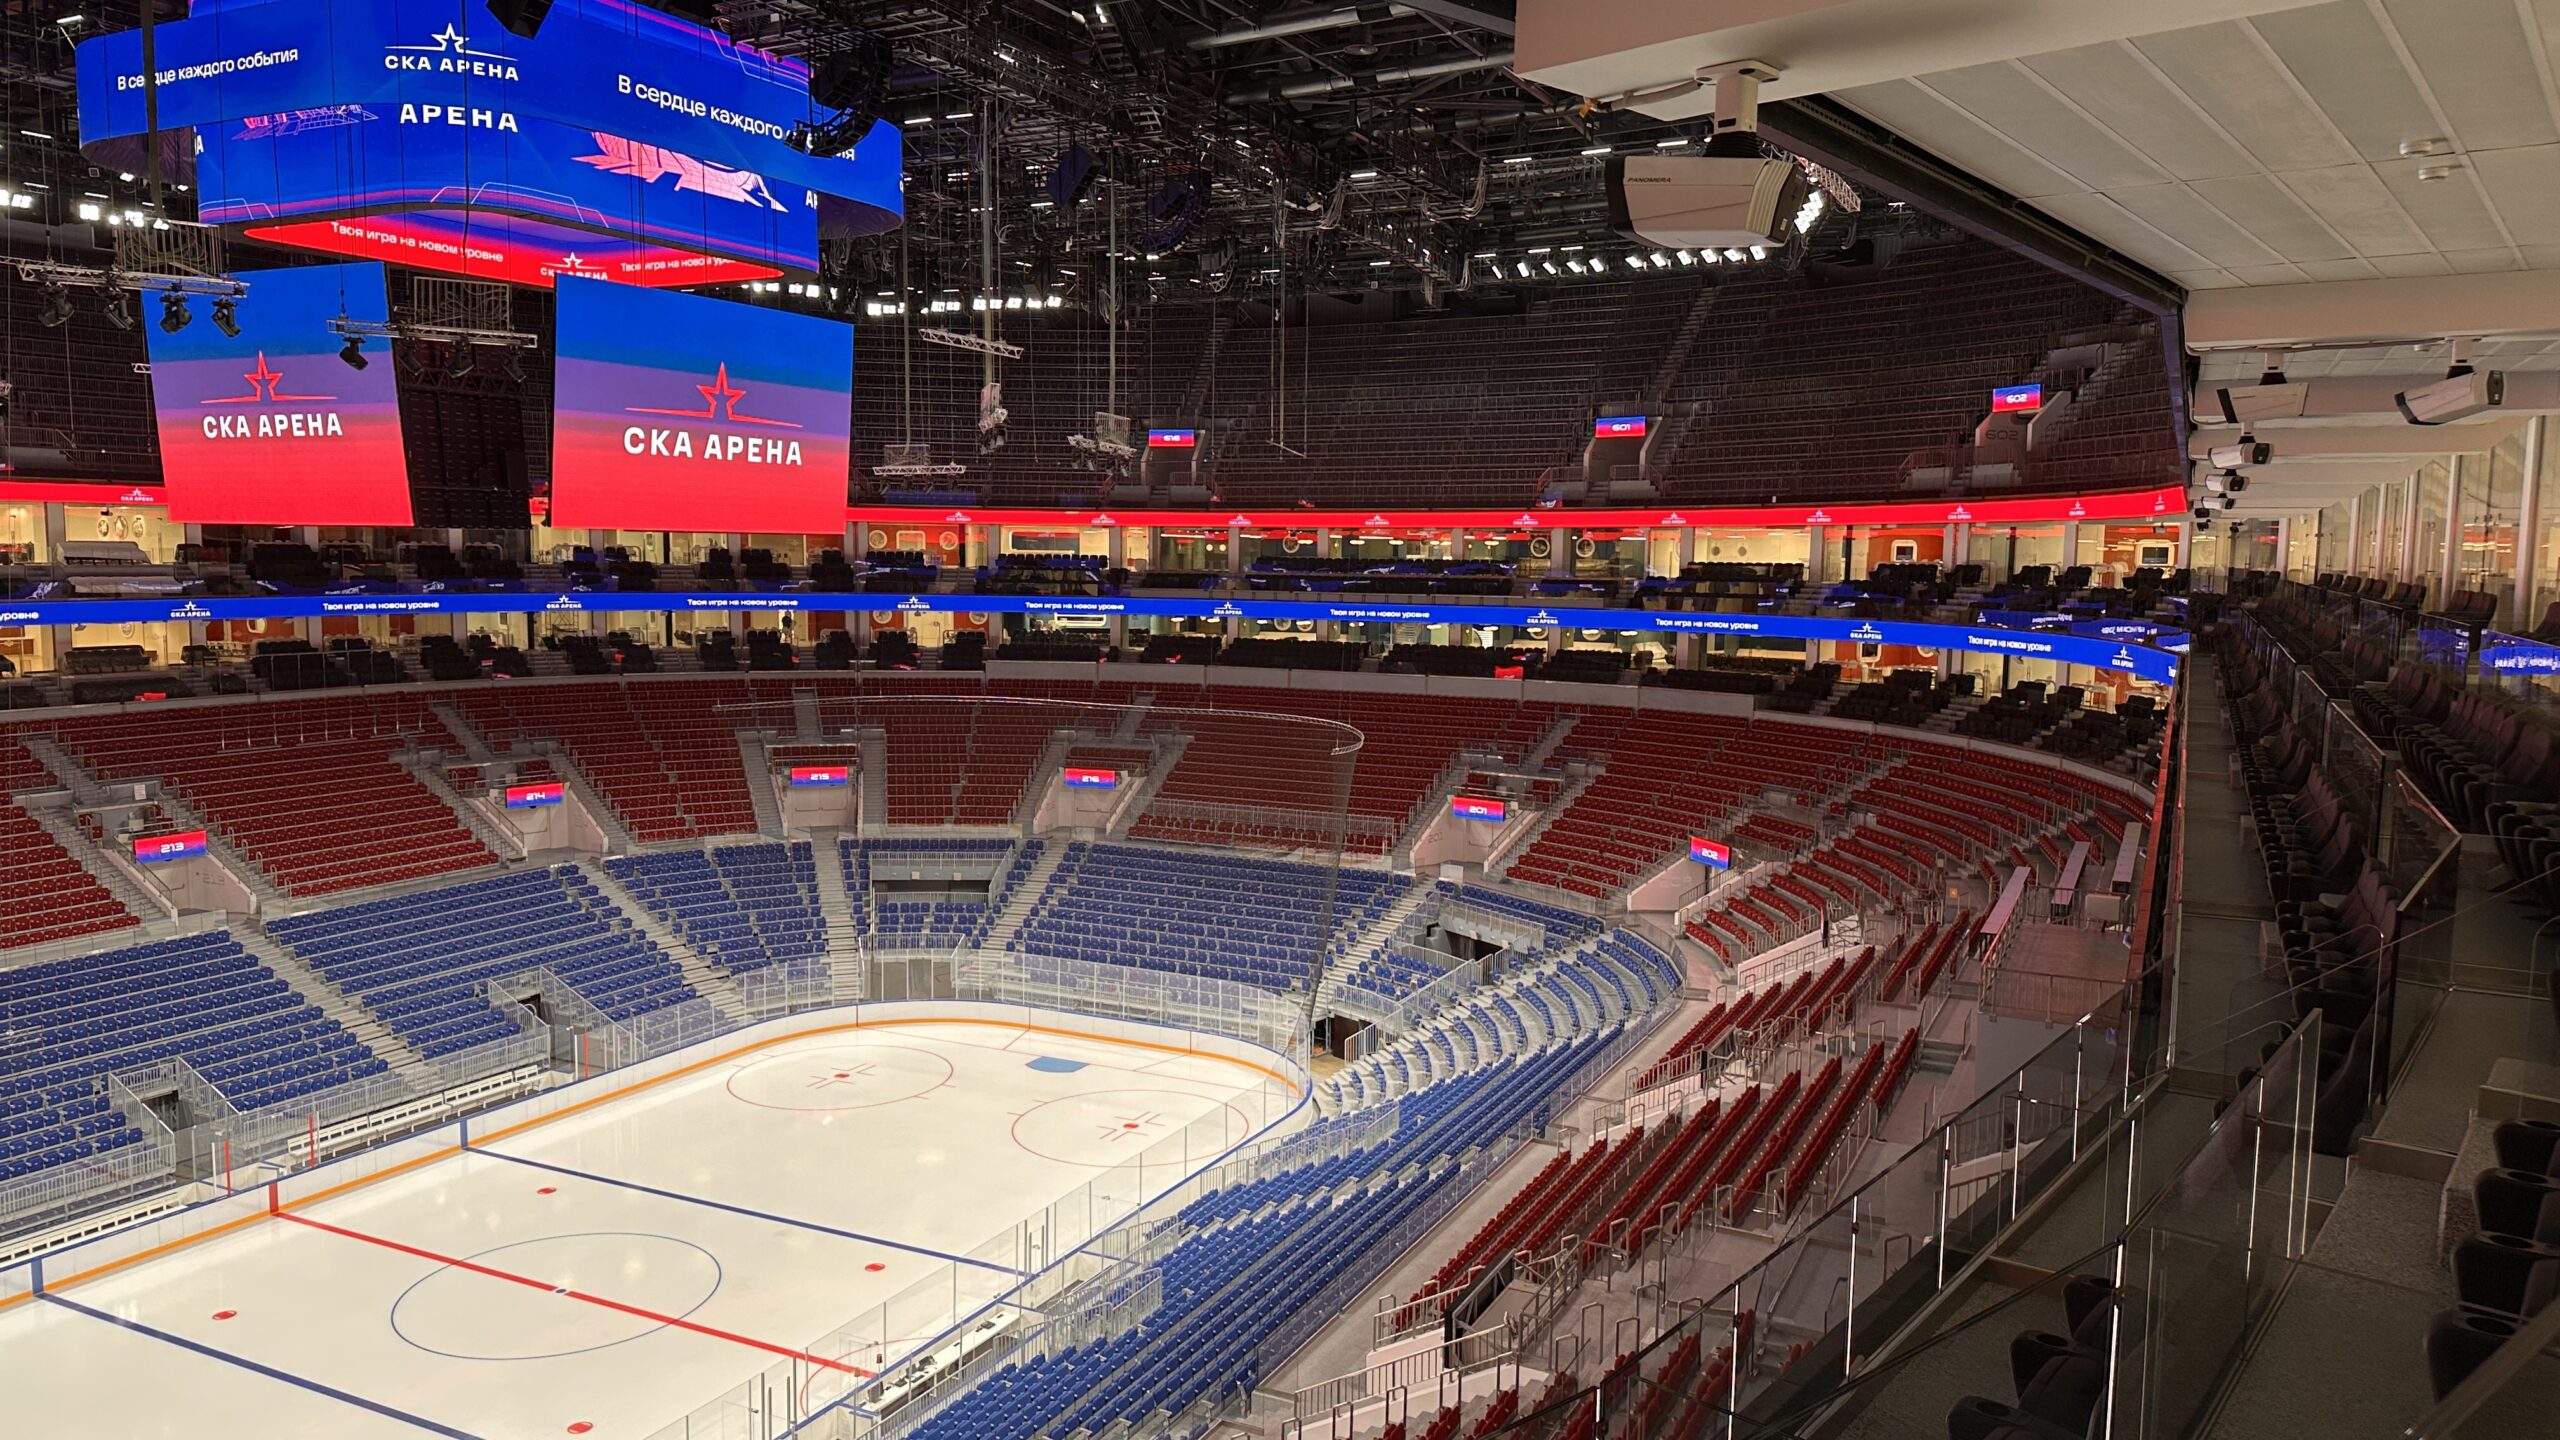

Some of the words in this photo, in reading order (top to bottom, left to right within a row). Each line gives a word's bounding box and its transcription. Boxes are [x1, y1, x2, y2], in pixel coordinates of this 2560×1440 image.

[117, 75, 127, 91] В
[178, 59, 235, 80] каждого
[237, 48, 299, 70] события
[384, 55, 432, 71] СКА
[439, 58, 519, 81] АРЕНА
[618, 74, 631, 94] В
[635, 82, 707, 118] сердце
[710, 105, 783, 140] каждого
[400, 103, 519, 133] АРЕНА
[331, 221, 364, 237] Твоя
[366, 231, 397, 244] игра
[400, 236, 416, 247] на
[419, 239, 458, 255] новом
[667, 259, 680, 269] на
[2006, 393, 2028, 404] 602
[203, 415, 252, 439] СКА
[258, 412, 343, 438] АРЕНА
[1612, 423, 1631, 432] 601
[623, 426, 693, 459] СКА
[703, 433, 803, 466] АРЕНА
[170, 610, 185, 618] СКА
[187, 610, 211, 618] АРЕНА
[526, 791, 546, 801] 214
[1468, 805, 1488, 815] 201
[160, 841, 185, 854] 213
[1701, 847, 1719, 861] 202
